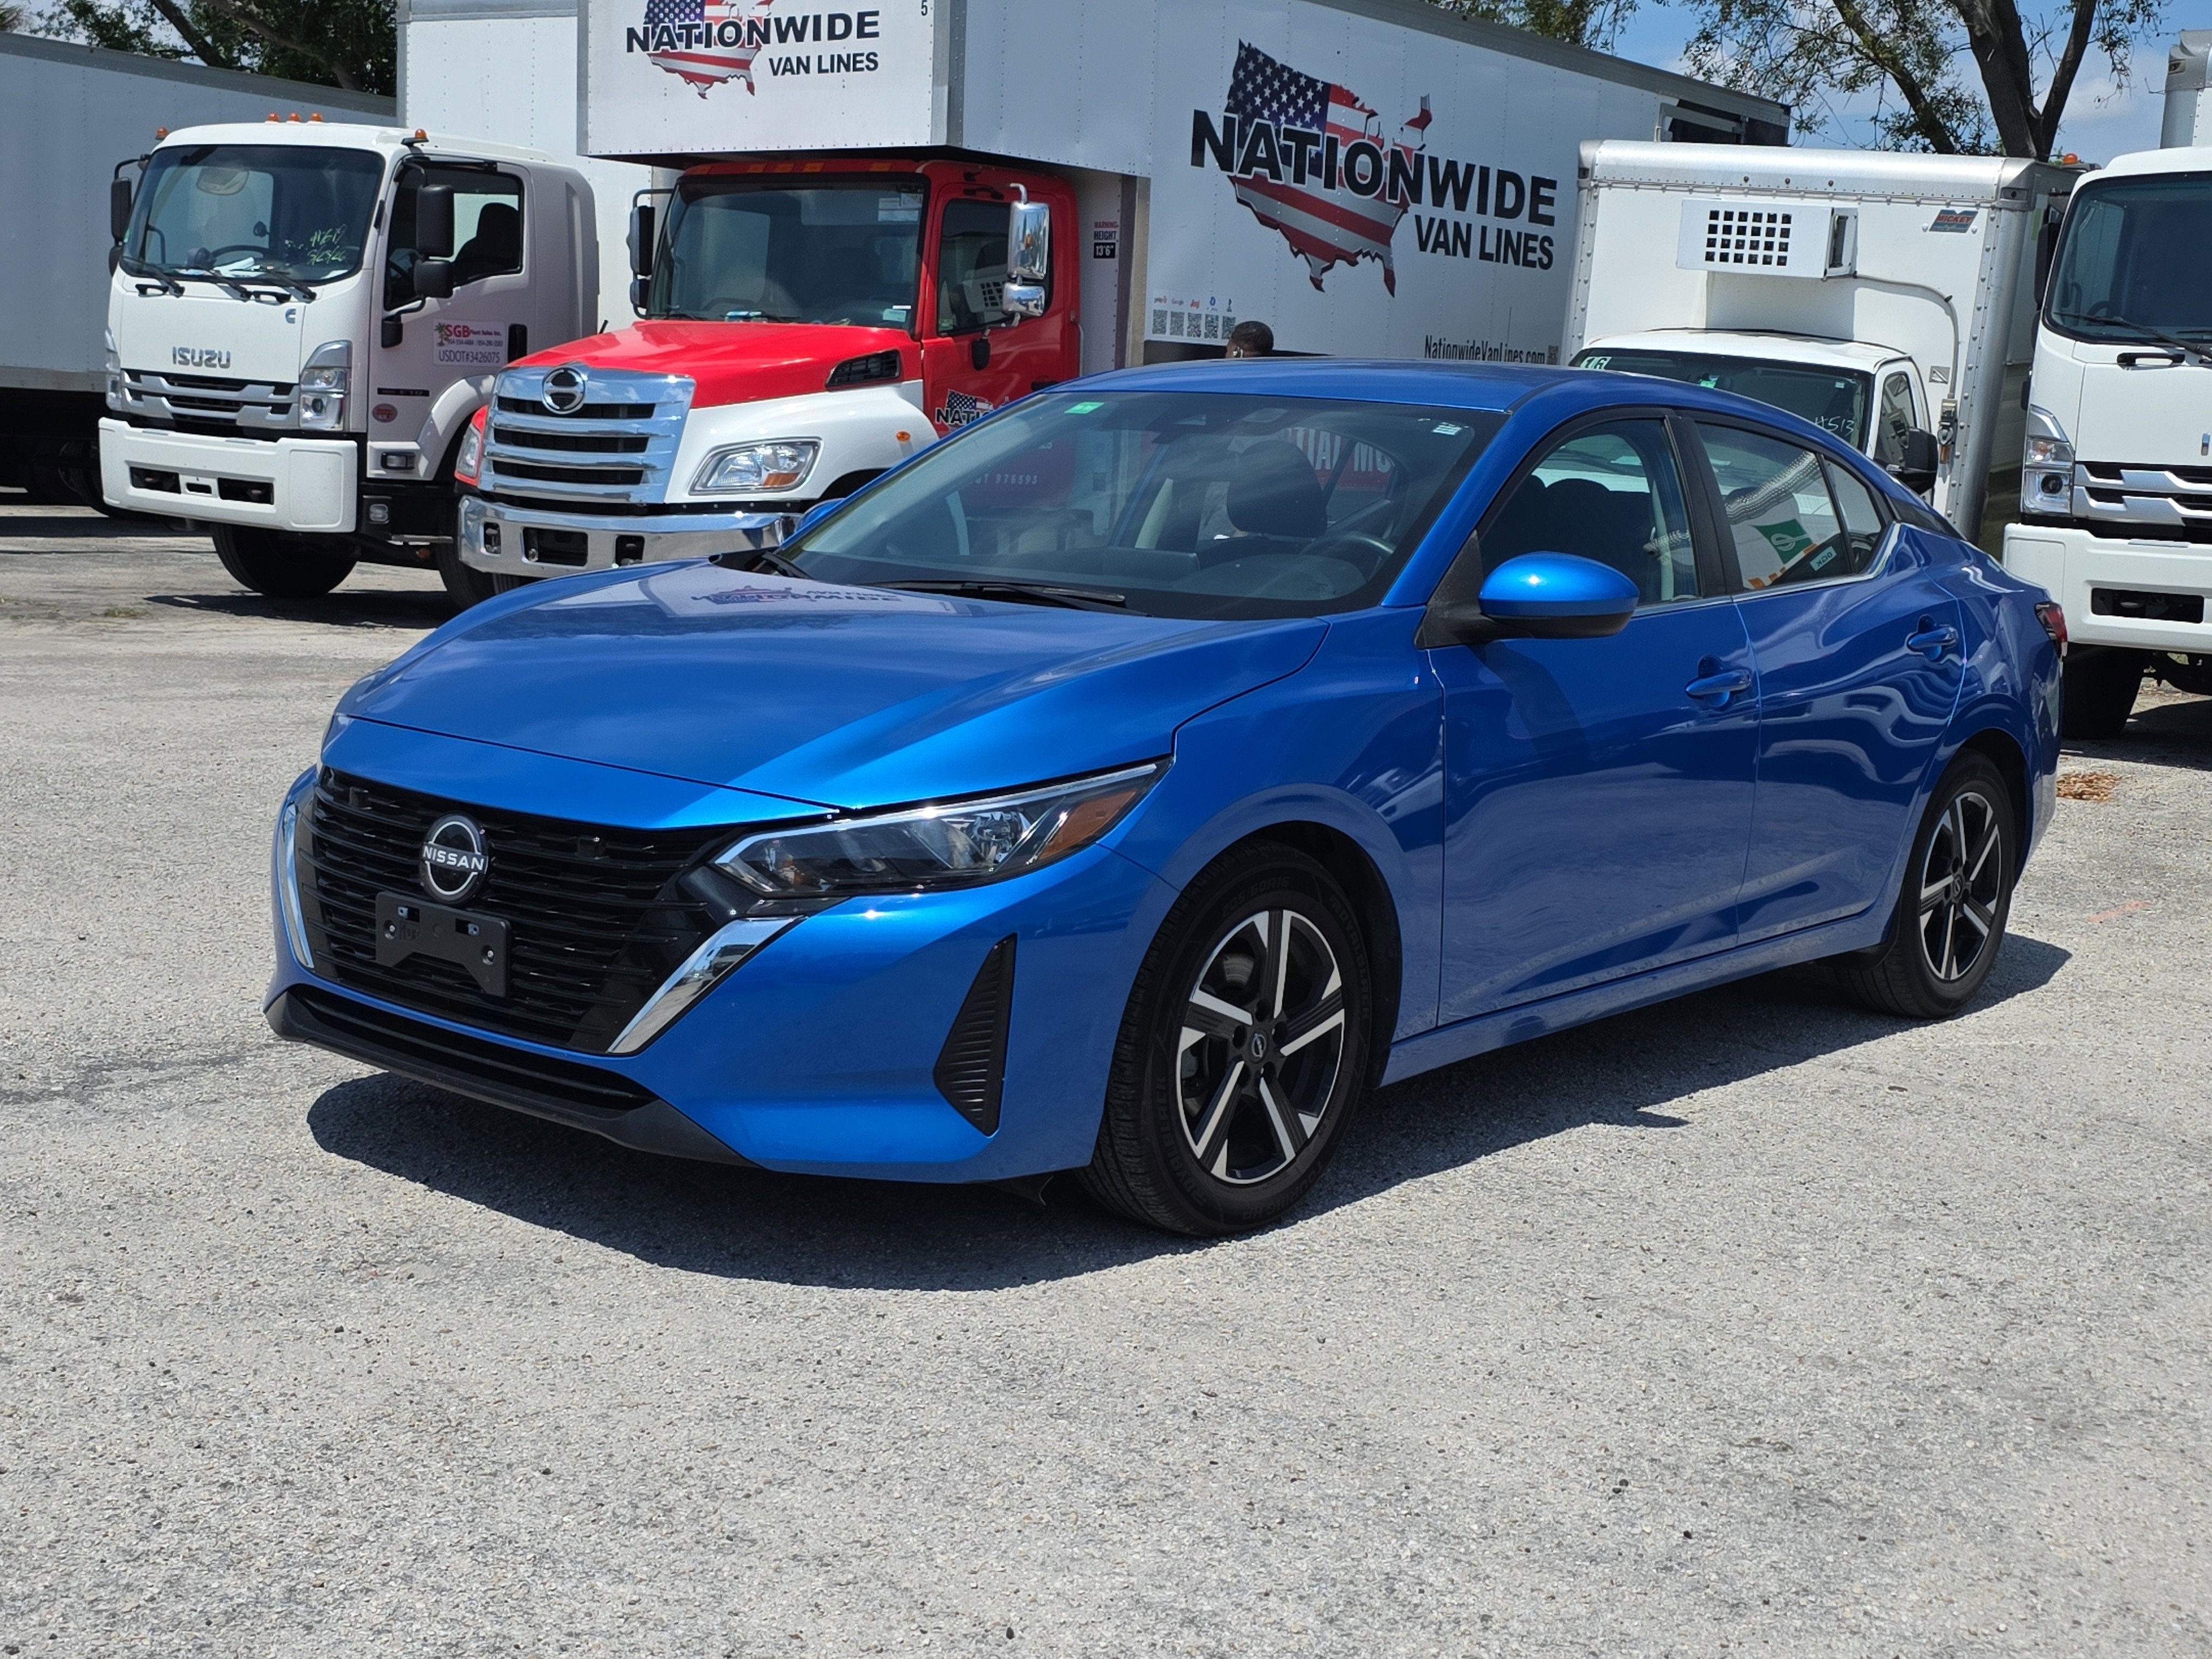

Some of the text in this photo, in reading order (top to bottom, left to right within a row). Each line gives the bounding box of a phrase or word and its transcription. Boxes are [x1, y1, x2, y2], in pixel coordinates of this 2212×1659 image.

[626, 10, 880, 53] NATIONWIDE
[769, 52, 879, 76] VAN LINES
[1191, 109, 1557, 227] NATIONWIDE
[1937, 215, 1972, 223] MICKEY
[1094, 231, 1117, 240] HEIGHT
[1414, 214, 1553, 271] VAN LINES
[1096, 245, 1114, 256] 13'6"
[445, 324, 471, 338] SGB
[172, 346, 231, 369] ISUZU
[438, 350, 500, 363] USDOT#3426075
[1424, 335, 1545, 364] NationwideVanLinescom
[423, 846, 484, 871] NISSAN
